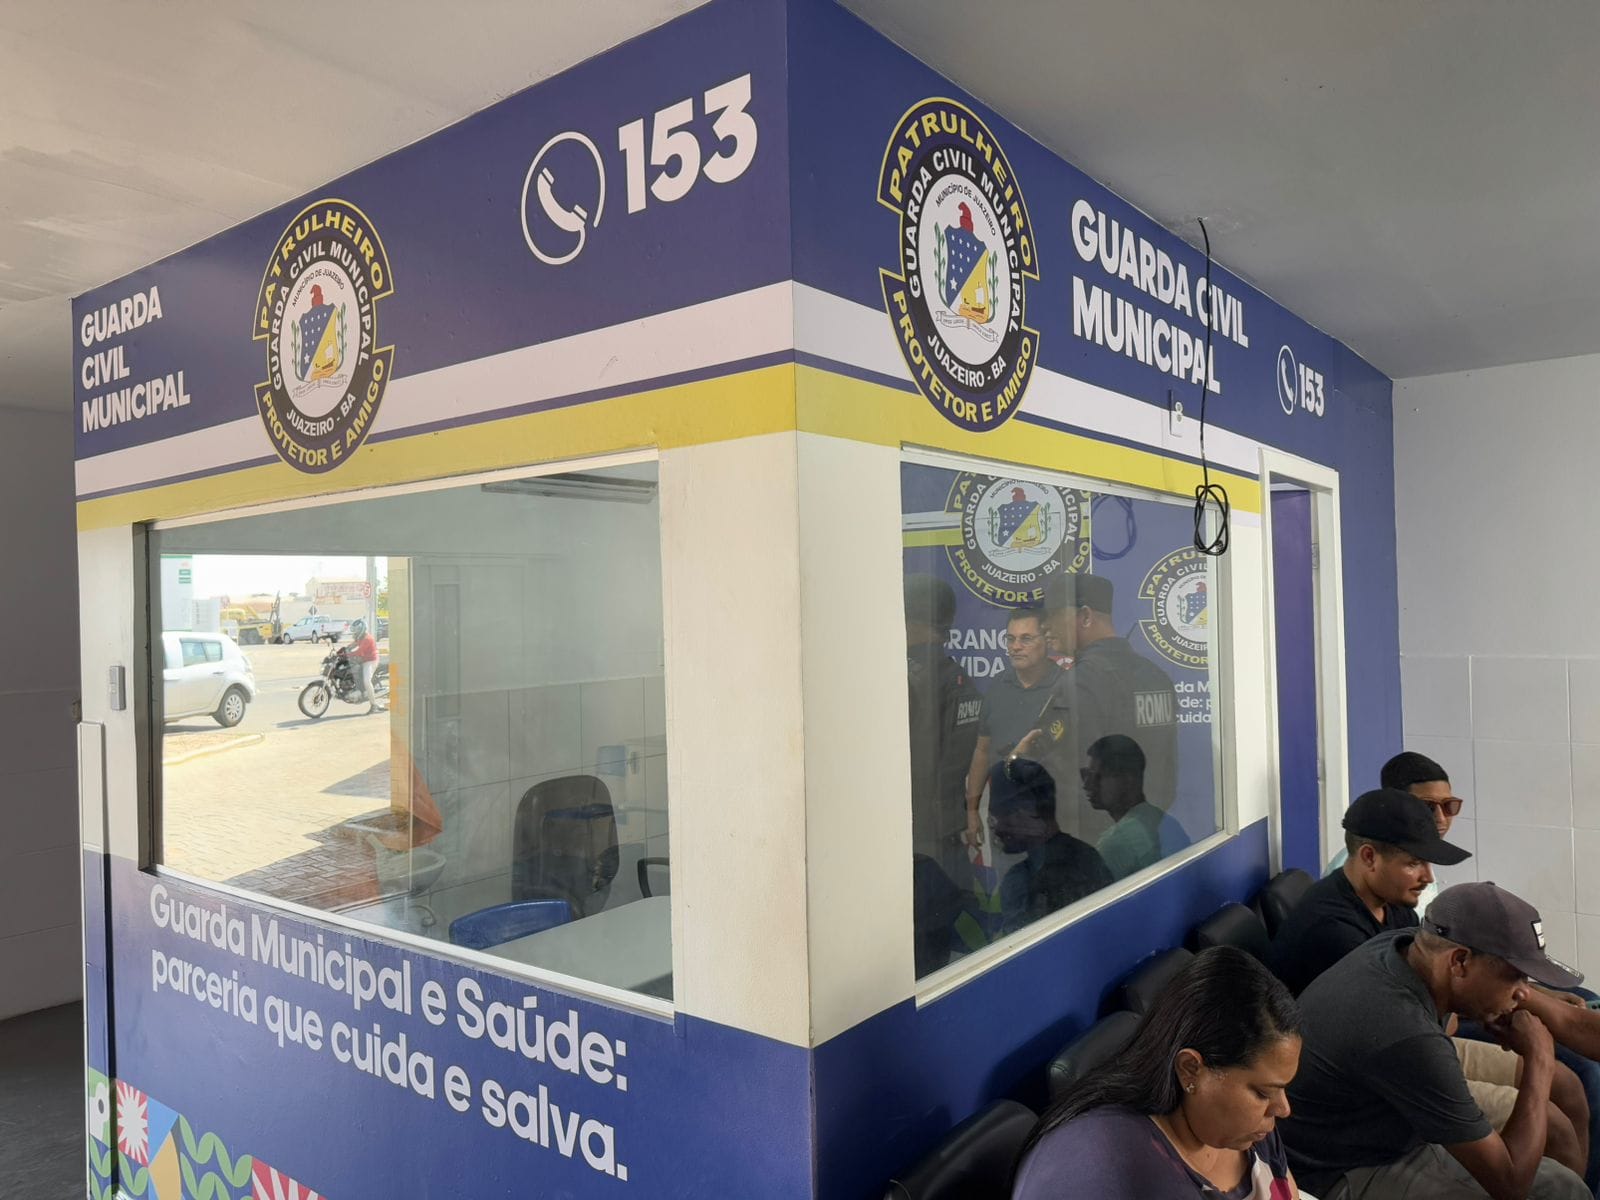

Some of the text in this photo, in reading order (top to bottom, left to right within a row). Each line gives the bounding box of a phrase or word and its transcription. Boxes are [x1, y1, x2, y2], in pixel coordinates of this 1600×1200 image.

[618, 73, 758, 215] 153
[889, 110, 1031, 267] PATRULHEIRO
[963, 188, 973, 198] DE
[259, 209, 384, 330] PATRULHEIRO
[905, 148, 1021, 333] GUARDA CIVIL MUNICIPAL
[314, 268, 322, 279] DE
[1071, 199, 1249, 349] GUARDA CIVIL
[81, 285, 163, 347] GUARDA
[272, 240, 373, 392] GUARDA CIVIL MUNICIPAL
[1073, 275, 1221, 395] MUNICIPAL
[82, 345, 130, 390] CIVIL
[893, 290, 1031, 423] PROTETOR E AMIGO
[927, 334, 985, 388] JUAZEIRO
[990, 355, 1007, 380] BA
[82, 371, 190, 433] MUNICIPAL
[262, 358, 385, 466] PROTETOR E AMIGO
[286, 408, 335, 437] JUAZEIRO
[340, 392, 357, 417] BA
[1298, 363, 1325, 418] 153
[964, 482, 1079, 550] GUARDA ICIPAL
[955, 549, 1029, 602] PROTETOR
[1032, 587, 1045, 601] E
[982, 563, 1036, 584] JUAZEIRO
[1043, 559, 1061, 575] BA
[1157, 575, 1176, 626] GUARDA
[1148, 624, 1209, 664] PROTETOR
[1136, 693, 1173, 725] ROMU
[149, 884, 629, 1092] Guarda Municipal e Saúde:
[151, 949, 629, 1182] parceria que cuida e salva.
